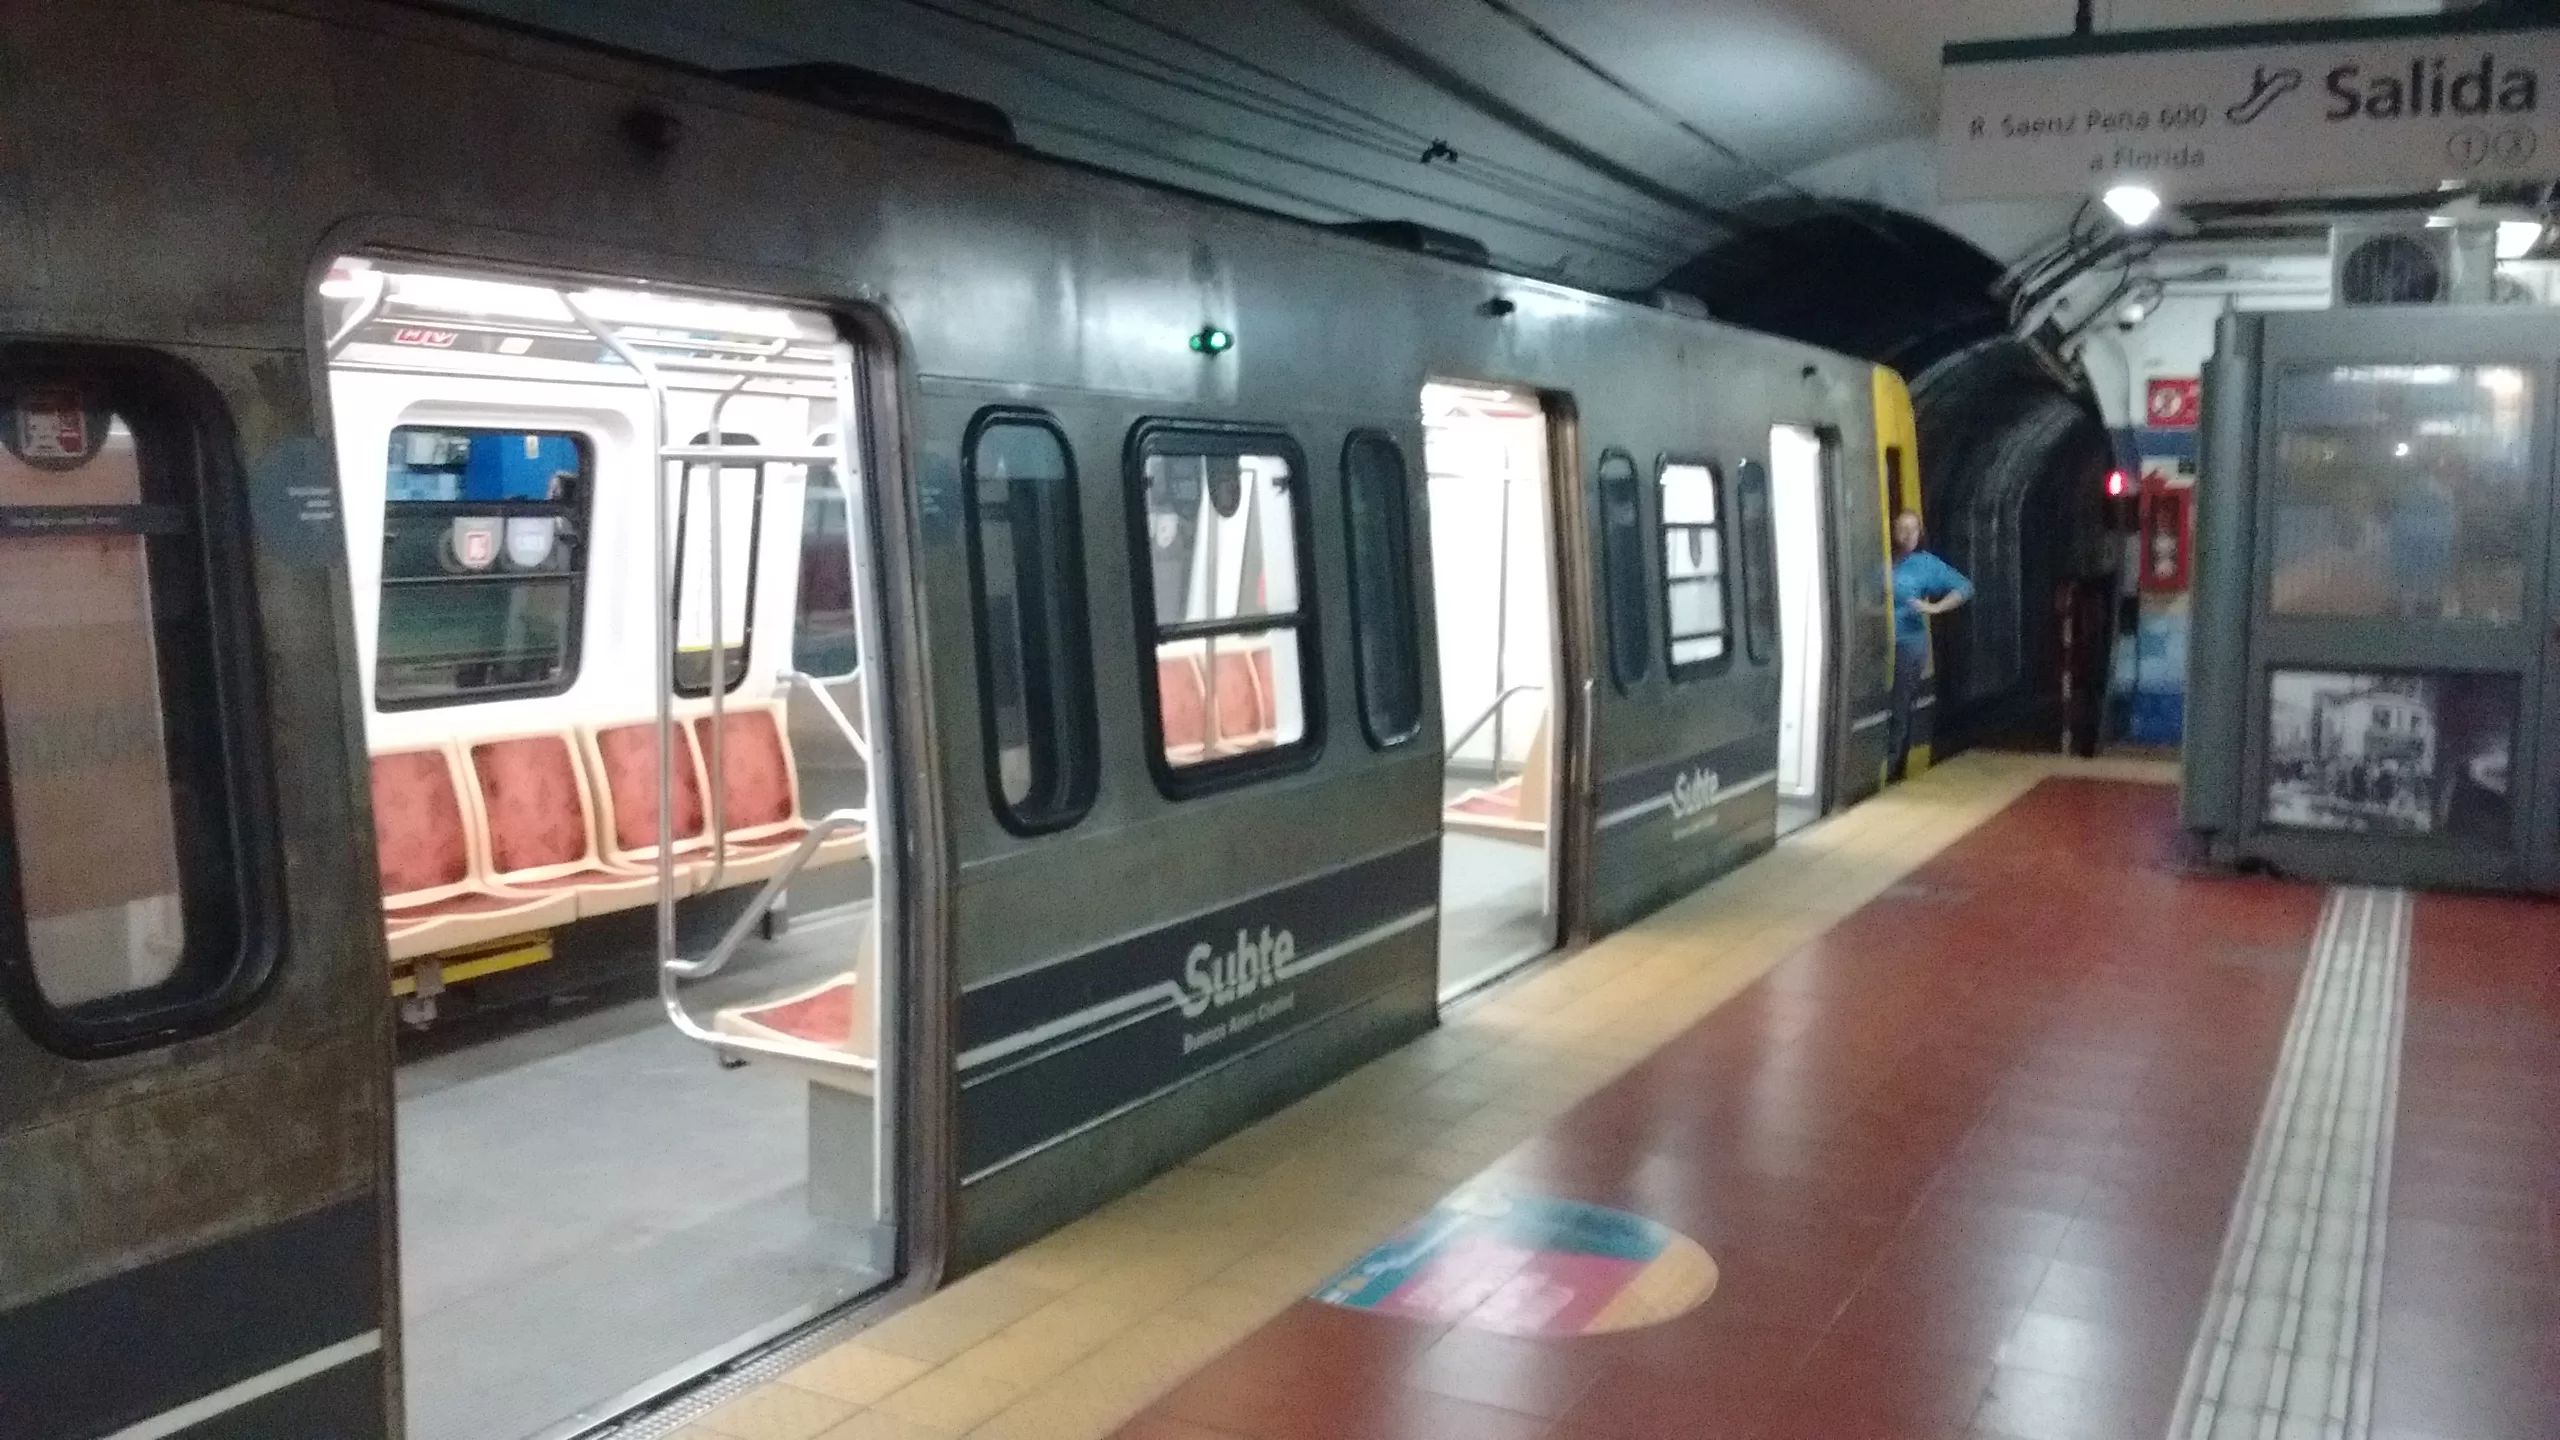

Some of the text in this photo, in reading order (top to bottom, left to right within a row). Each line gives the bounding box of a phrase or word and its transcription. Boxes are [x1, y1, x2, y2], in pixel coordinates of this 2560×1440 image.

[2325, 52, 2538, 122] Salida
[2113, 144, 2205, 170] Florida
[1672, 766, 1719, 819] Subte
[1183, 925, 1296, 1018] Subte
